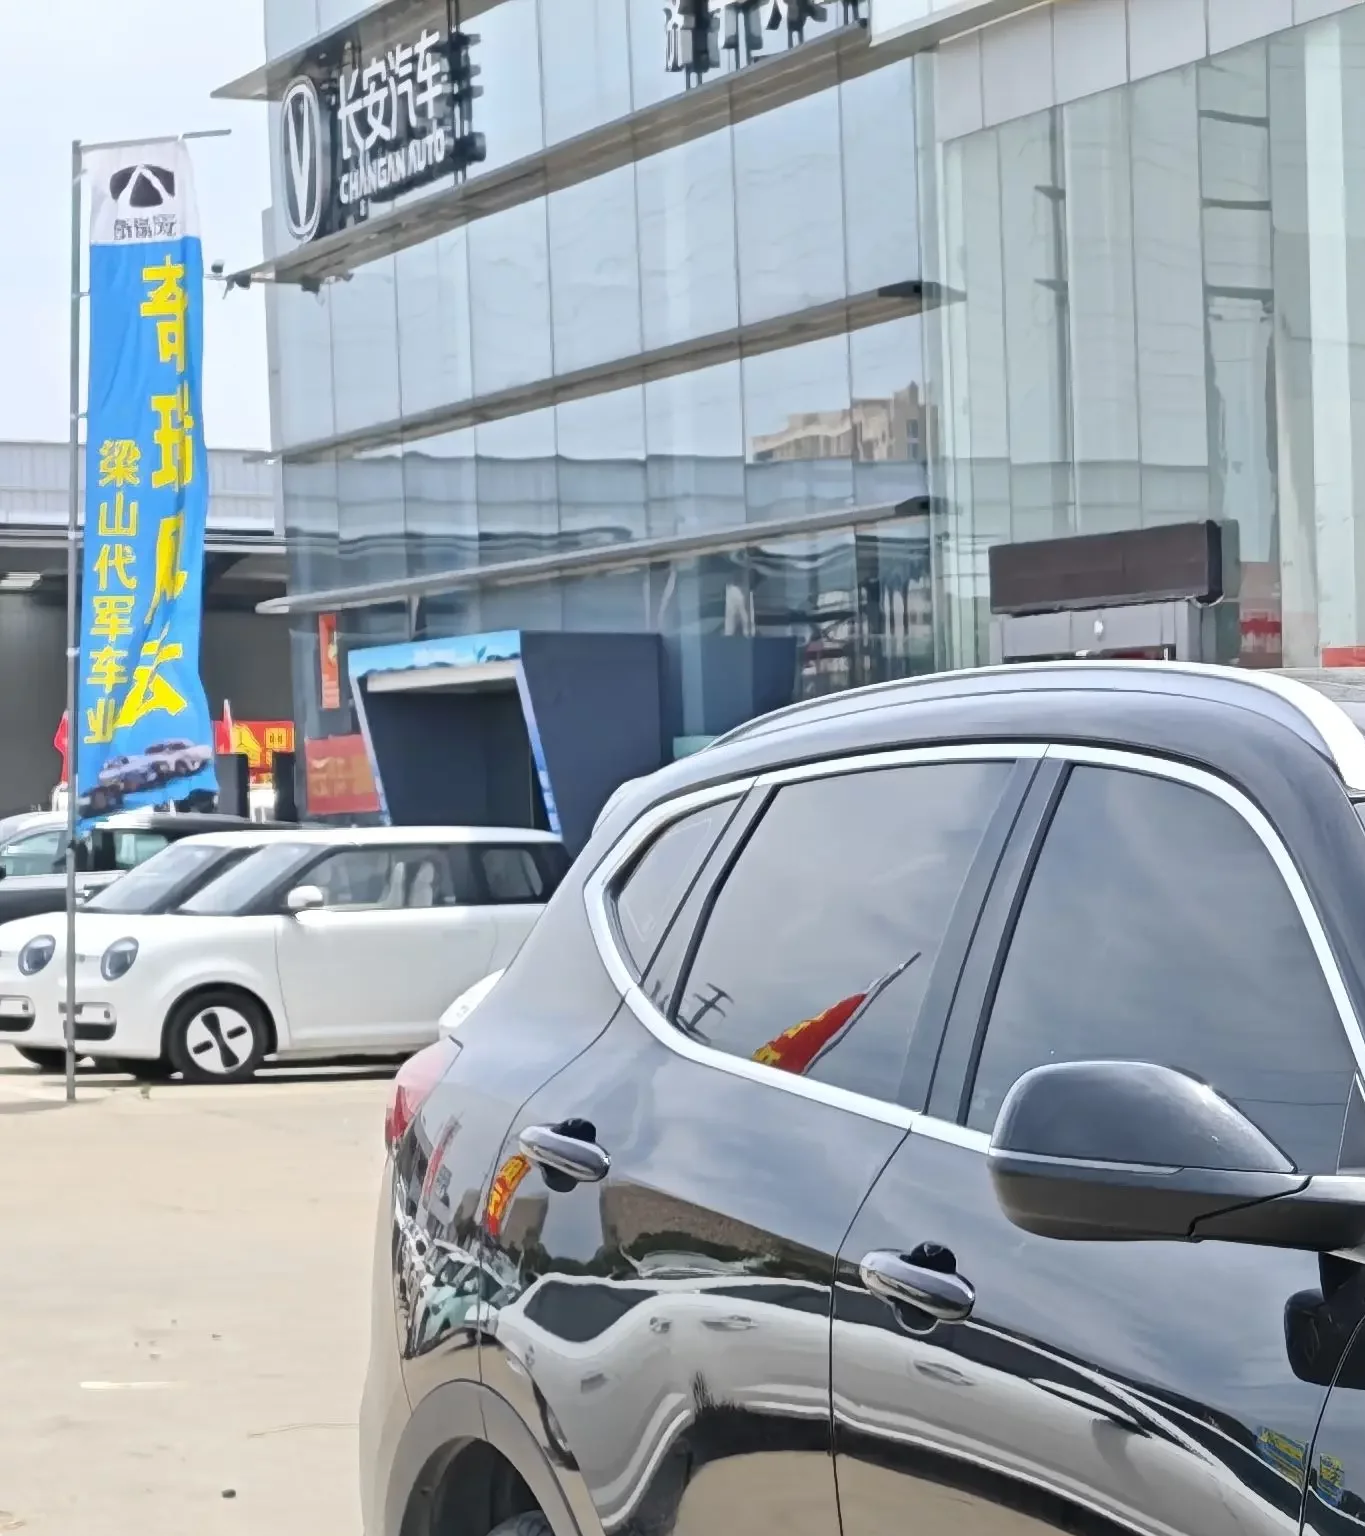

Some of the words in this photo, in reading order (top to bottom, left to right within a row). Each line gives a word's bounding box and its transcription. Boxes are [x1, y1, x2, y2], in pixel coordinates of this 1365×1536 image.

[338, 29, 443, 160] 长安汽车
[340, 147, 407, 204] CHANGAN
[406, 126, 446, 178] AUTO
